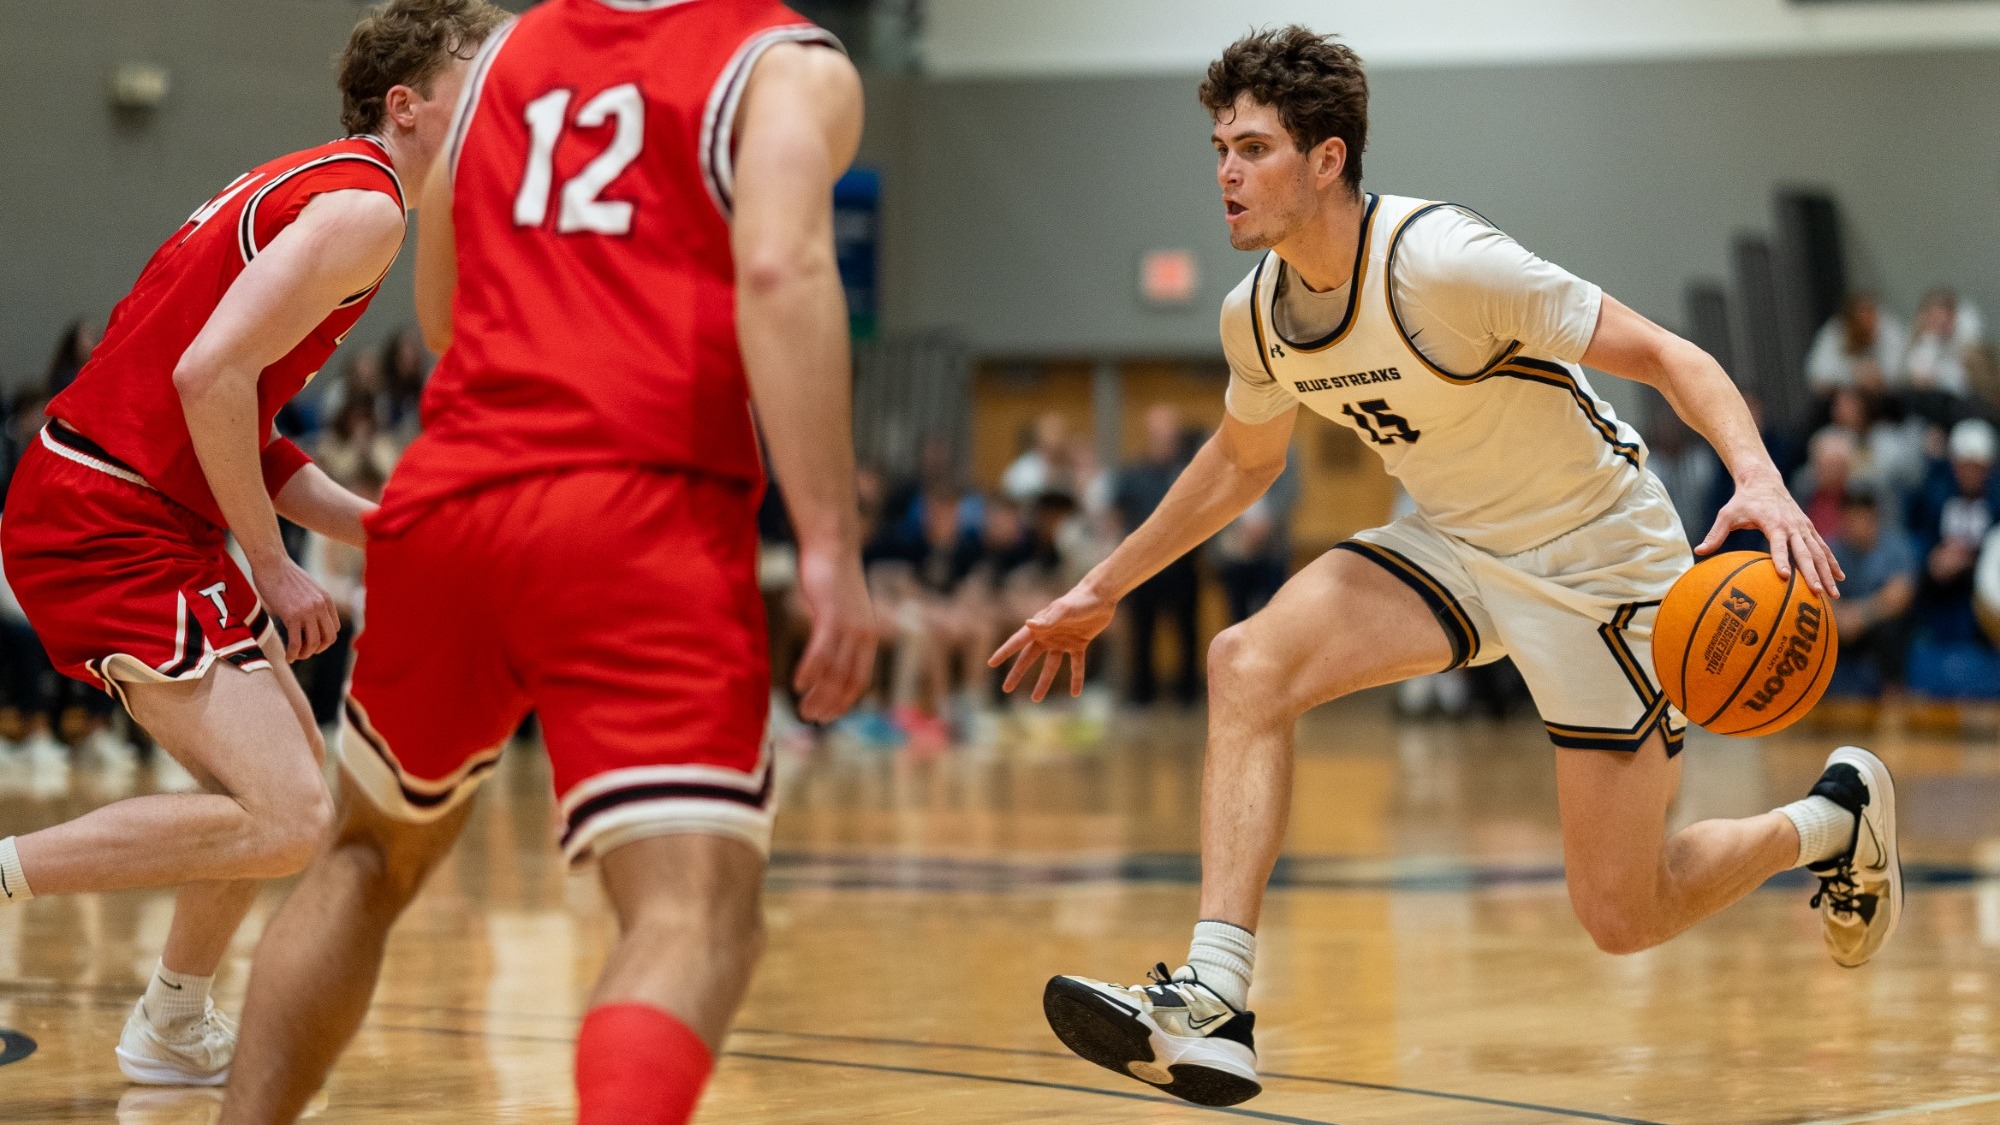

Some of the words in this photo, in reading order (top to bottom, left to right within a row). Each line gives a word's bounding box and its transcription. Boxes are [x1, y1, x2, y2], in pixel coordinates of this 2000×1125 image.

[512, 82, 646, 235] 12
[1341, 399, 1421, 444] 15
[1704, 612, 1731, 661] CHAMPIONSHIP
[1705, 617, 1740, 675] BASKETBALL
[1744, 601, 1821, 711] Wilson
